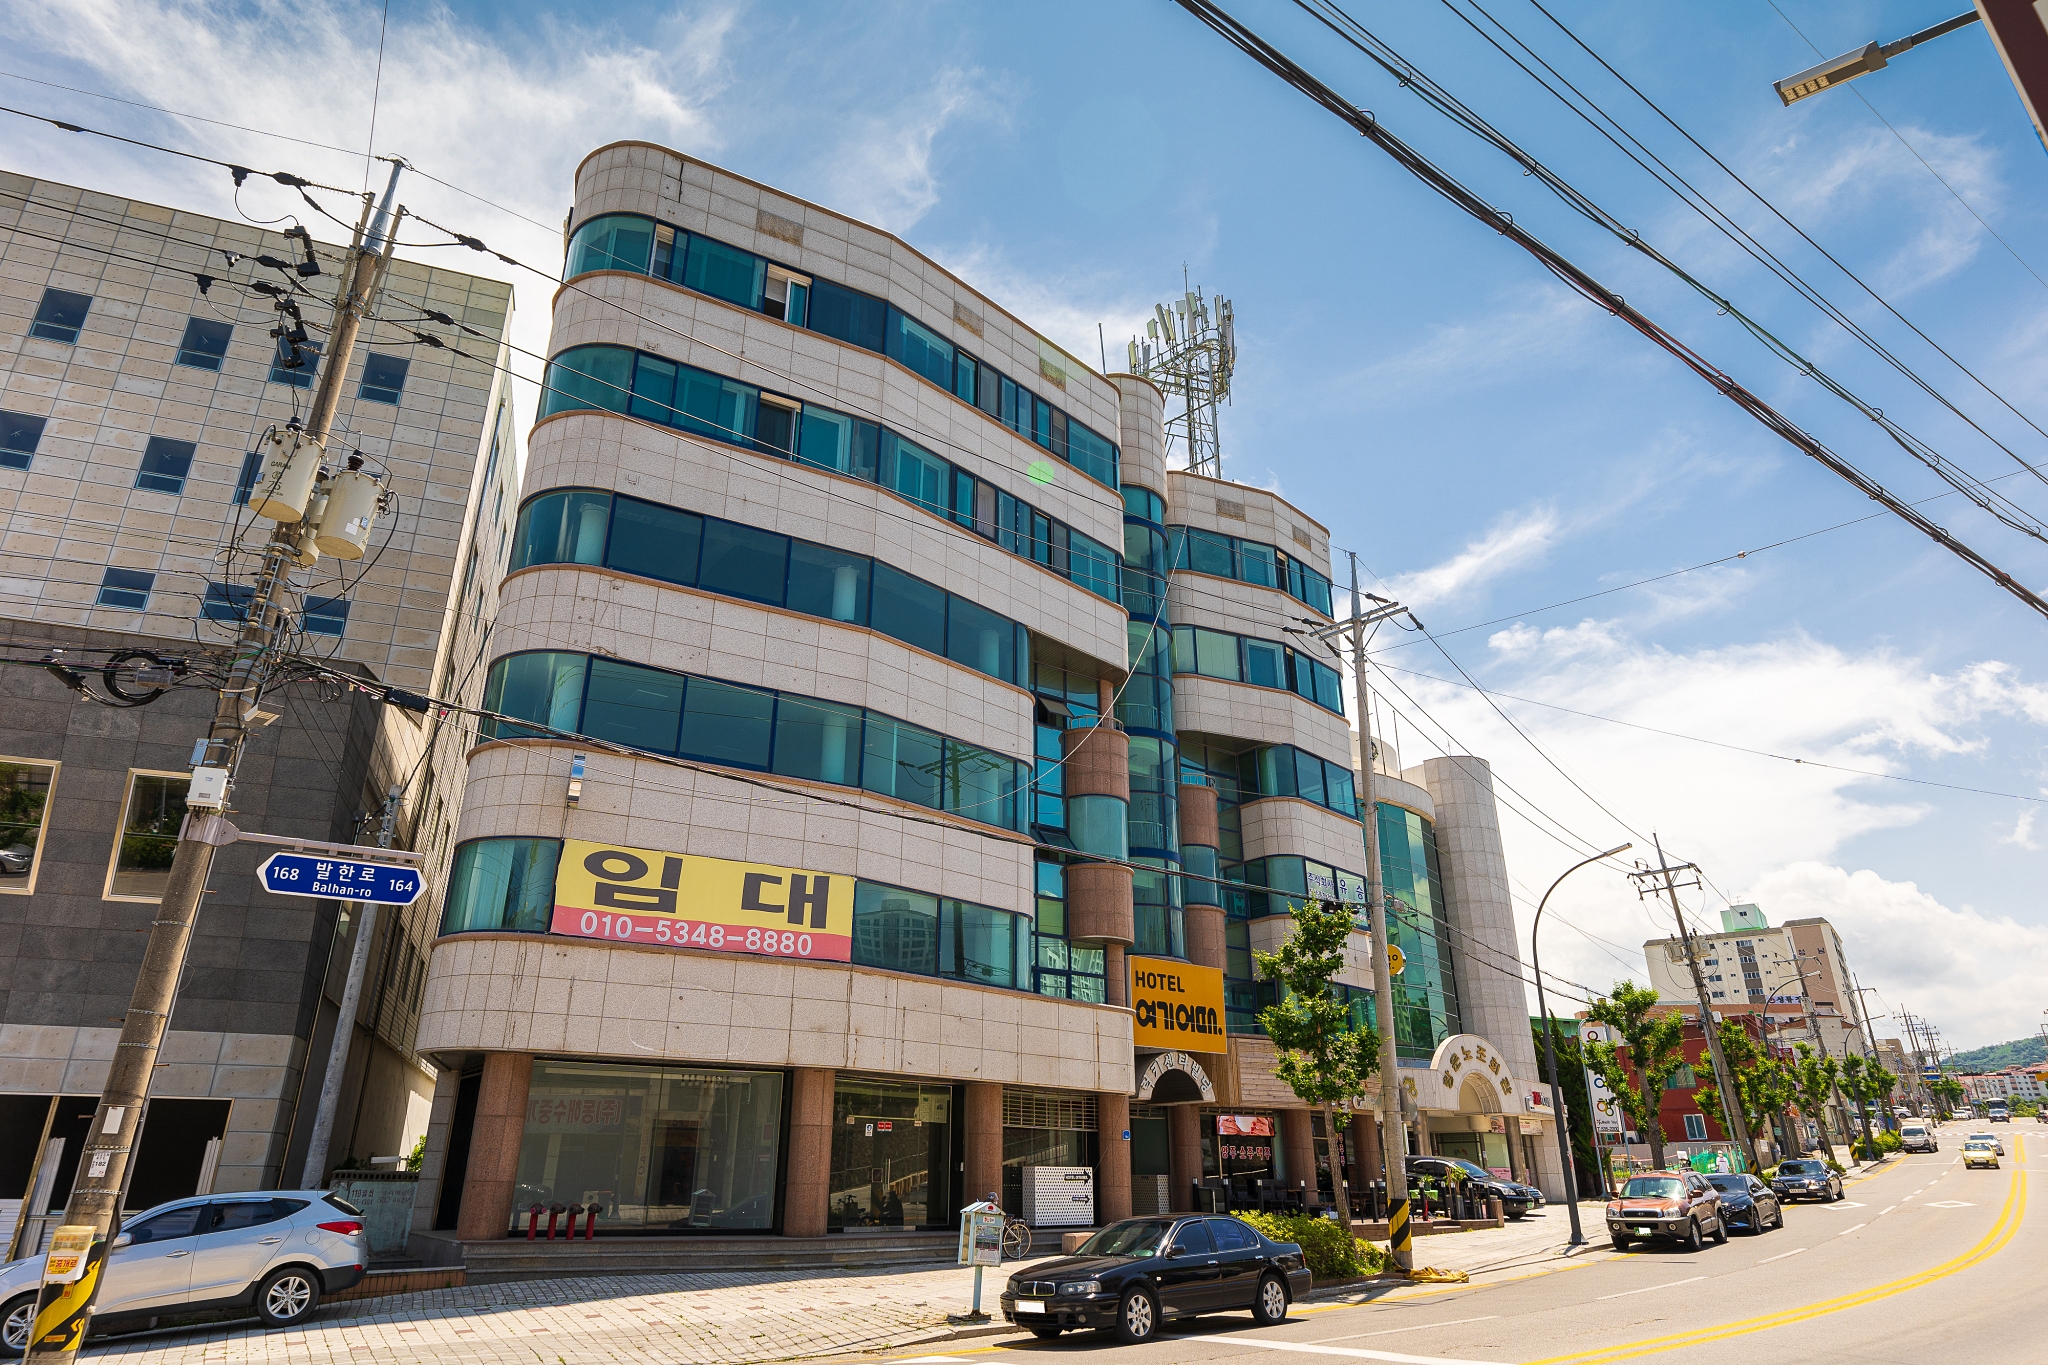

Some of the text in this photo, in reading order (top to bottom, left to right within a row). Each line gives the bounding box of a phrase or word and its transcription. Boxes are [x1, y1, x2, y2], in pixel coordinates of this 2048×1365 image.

[273, 866, 300, 881] 168
[315, 862, 376, 882] 발한로
[312, 881, 372, 898] Balhan-ro
[389, 879, 413, 892] 164
[580, 911, 813, 956] 010-5348-8880
[1135, 970, 1186, 993] HOTEL
